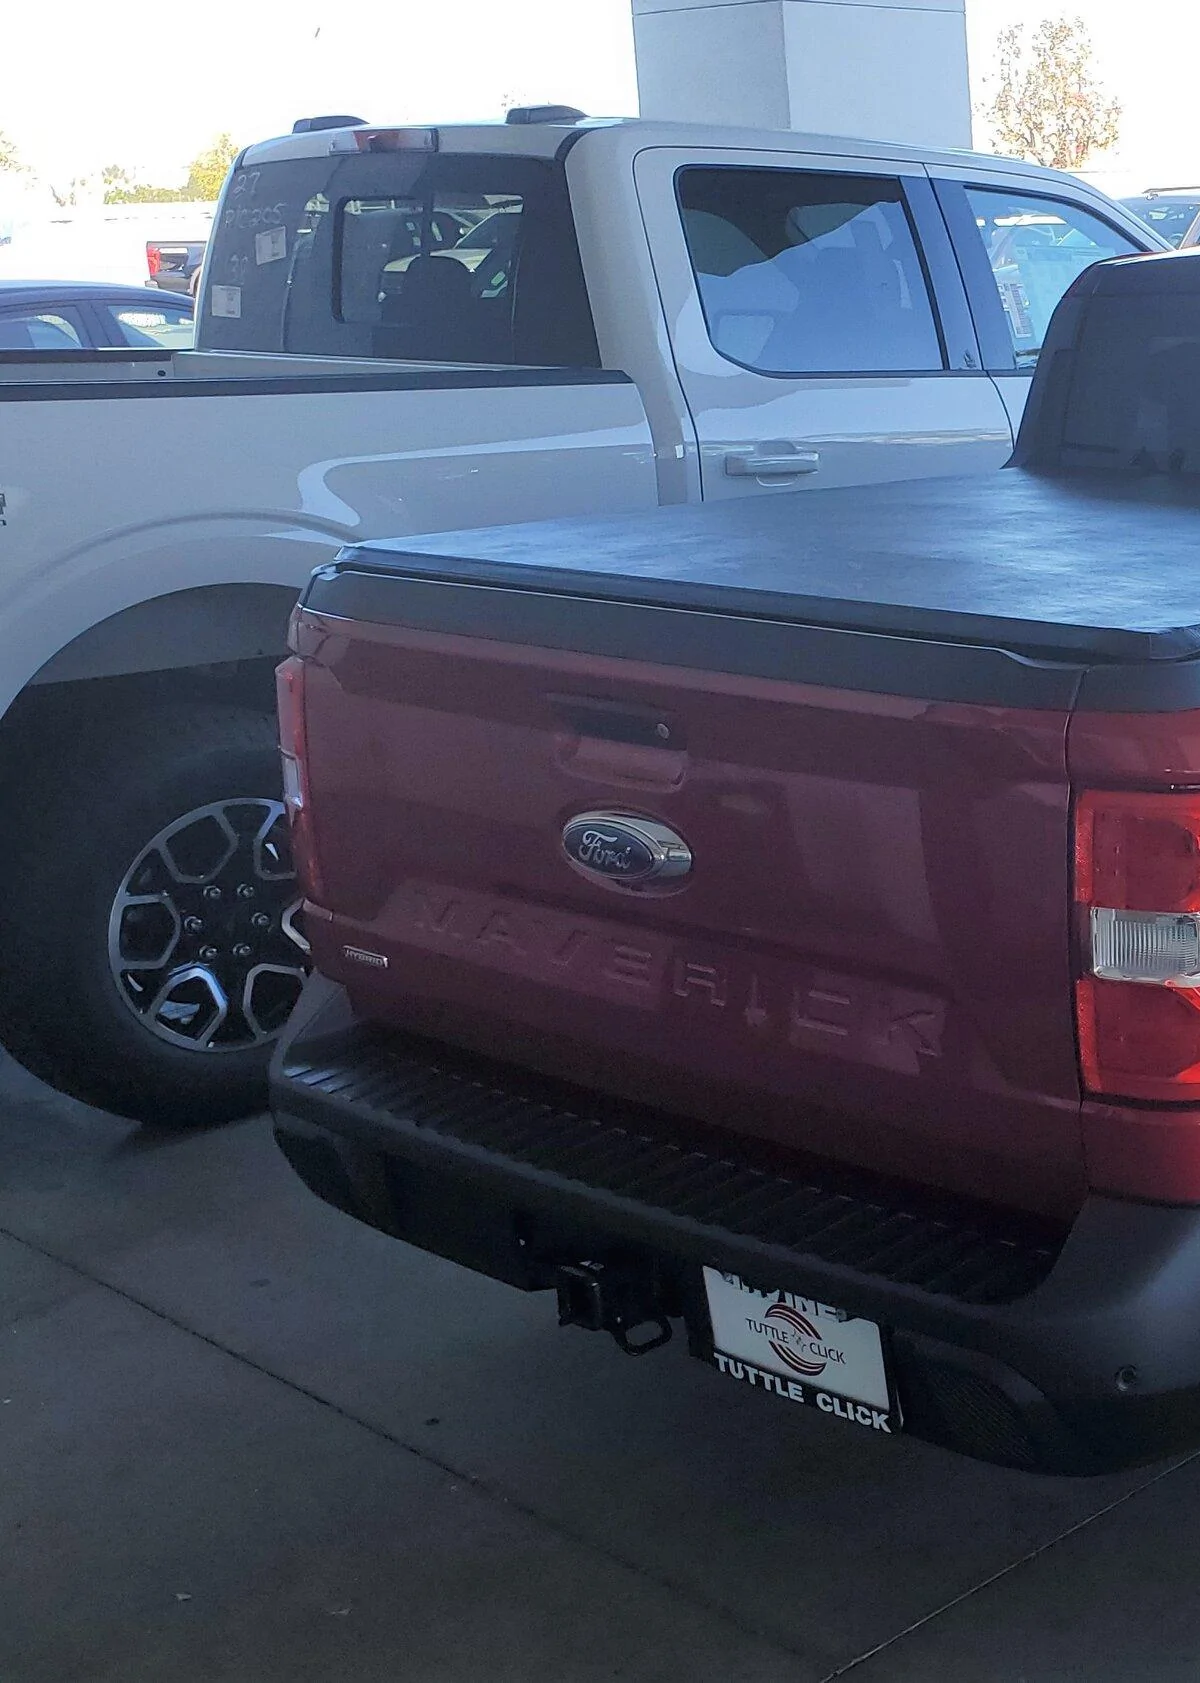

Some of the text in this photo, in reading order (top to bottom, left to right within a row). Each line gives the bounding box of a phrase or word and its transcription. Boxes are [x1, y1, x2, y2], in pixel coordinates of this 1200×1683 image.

[579, 830, 631, 869] Ford
[745, 1318, 847, 1365] TUTTLE CLICK
[714, 1352, 892, 1434] TUTTLE CLICK
